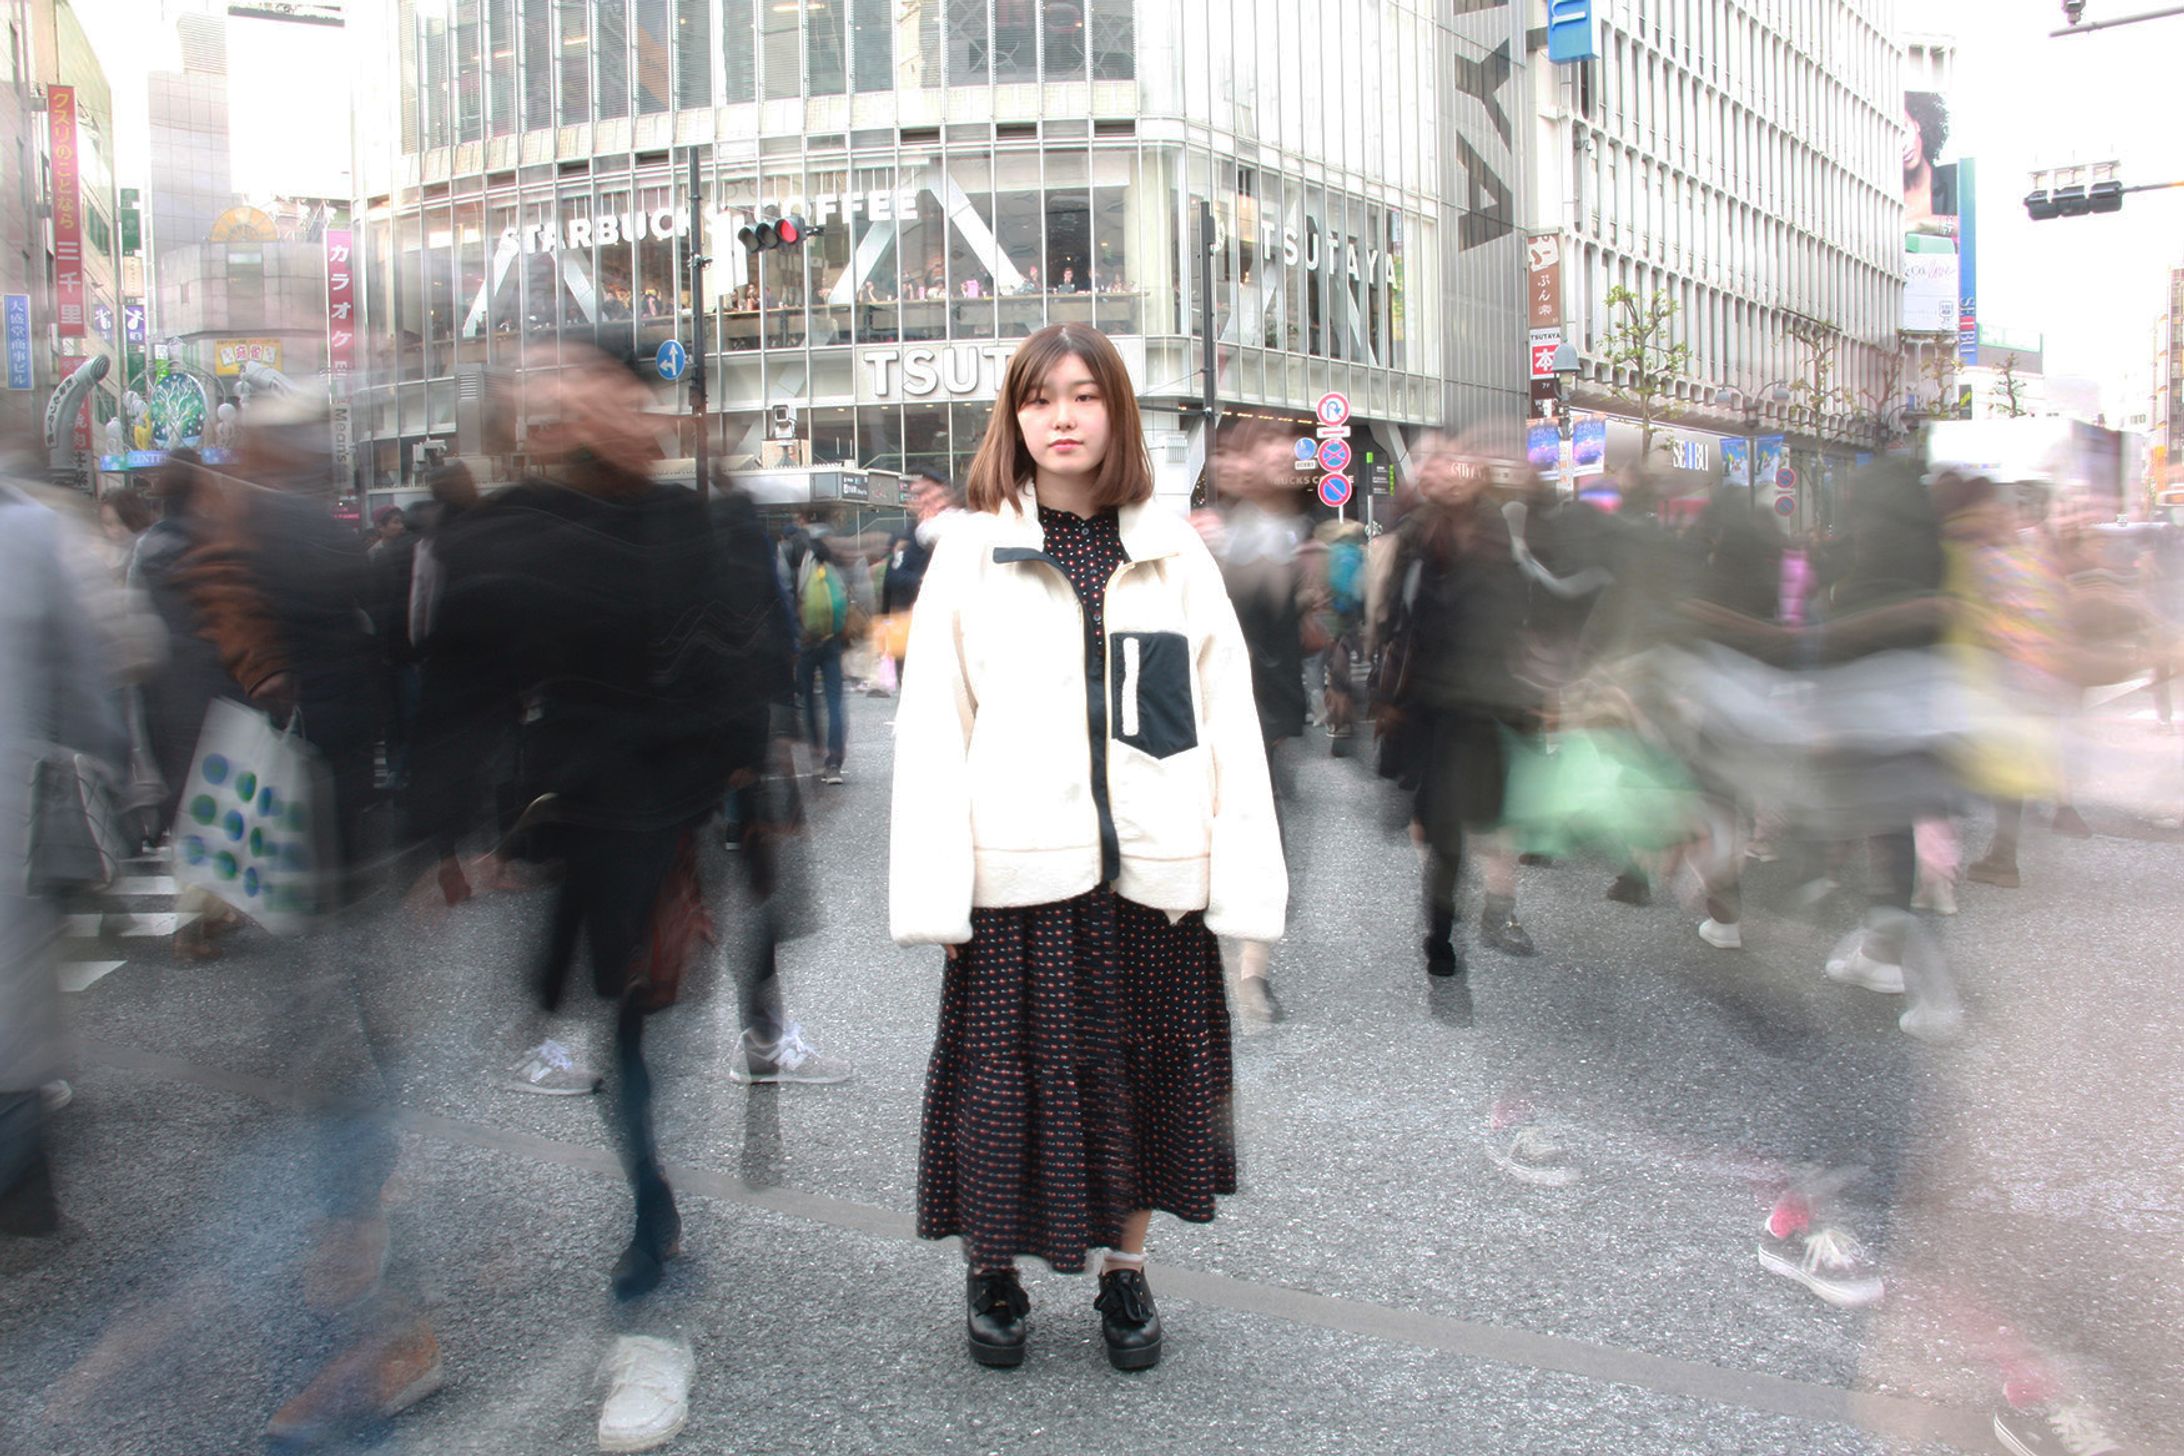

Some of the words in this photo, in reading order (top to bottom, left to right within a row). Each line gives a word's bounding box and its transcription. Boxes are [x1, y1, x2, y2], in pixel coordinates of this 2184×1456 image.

[53, 93, 74, 230] クスリのことなら
[1261, 219, 1397, 286] TSUTAYA
[56, 241, 83, 325] 三千里
[329, 244, 352, 348] カラオケ
[1531, 333, 1561, 341] TSUTAYA
[1960, 297, 1976, 353] SEIBU
[863, 345, 1017, 397] TSUT
[1535, 348, 1554, 371] 本
[1673, 439, 1709, 472] SEIBU
